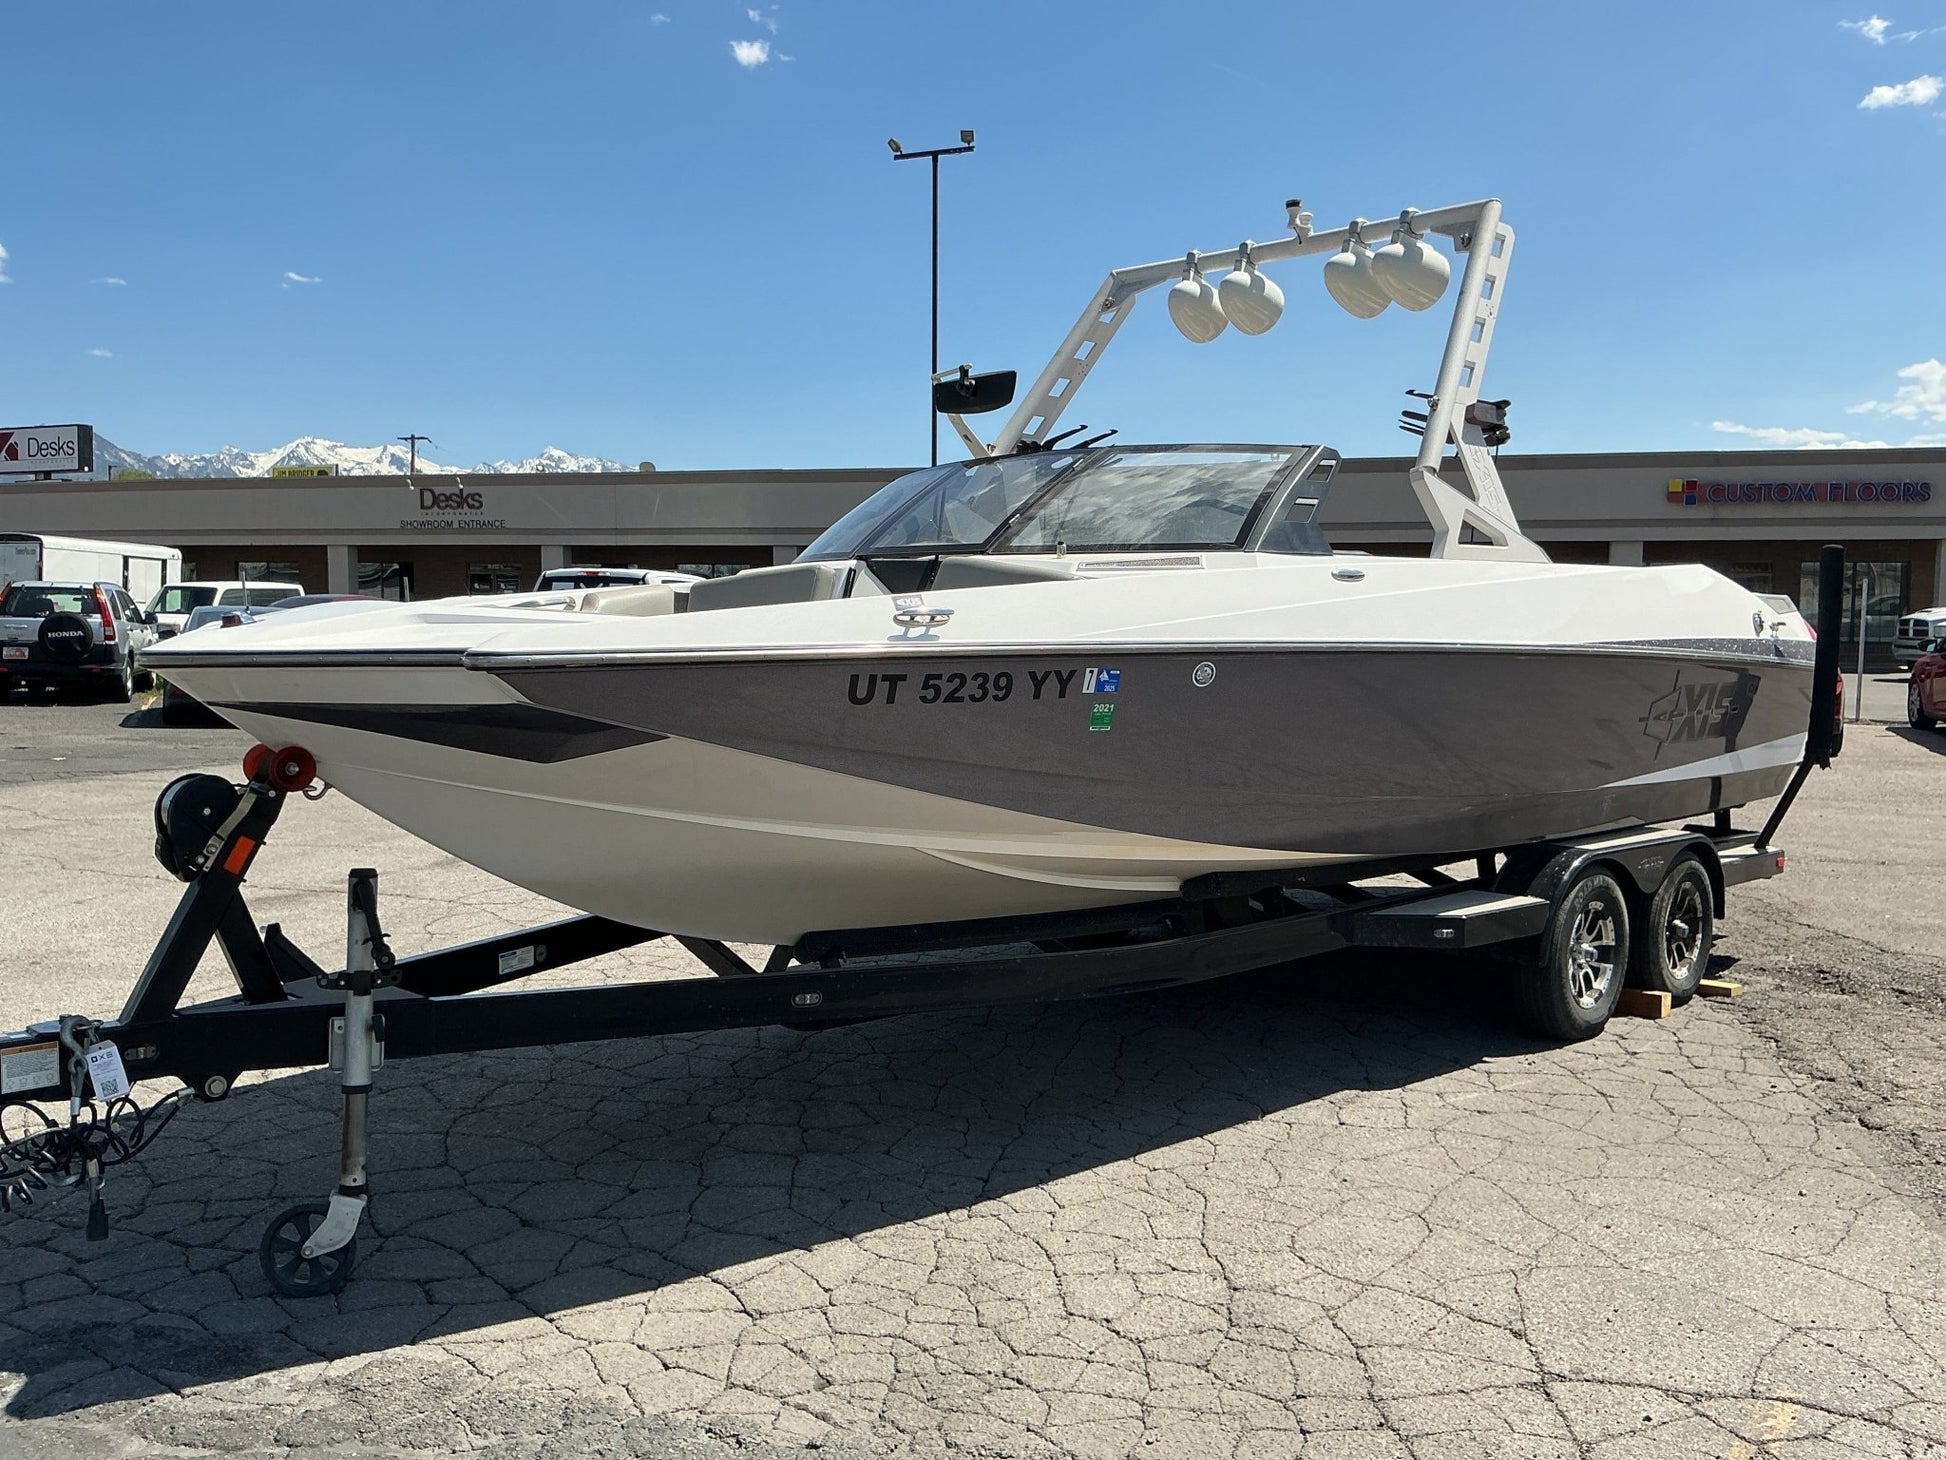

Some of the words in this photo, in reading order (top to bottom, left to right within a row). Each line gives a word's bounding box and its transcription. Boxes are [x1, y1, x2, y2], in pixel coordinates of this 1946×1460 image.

[27, 436, 75, 458] Desks
[419, 487, 484, 510] Desks
[1707, 482, 1819, 502] CUSTOM
[1827, 481, 1932, 502] FLOORS
[400, 519, 454, 529] SHOWROOM
[458, 519, 506, 529] ENTRANCE
[47, 630, 85, 638] HONDA
[847, 673, 908, 706] UT
[918, 671, 1014, 705] 5239
[1028, 669, 1078, 700] YY
[1093, 703, 1115, 712] 2021
